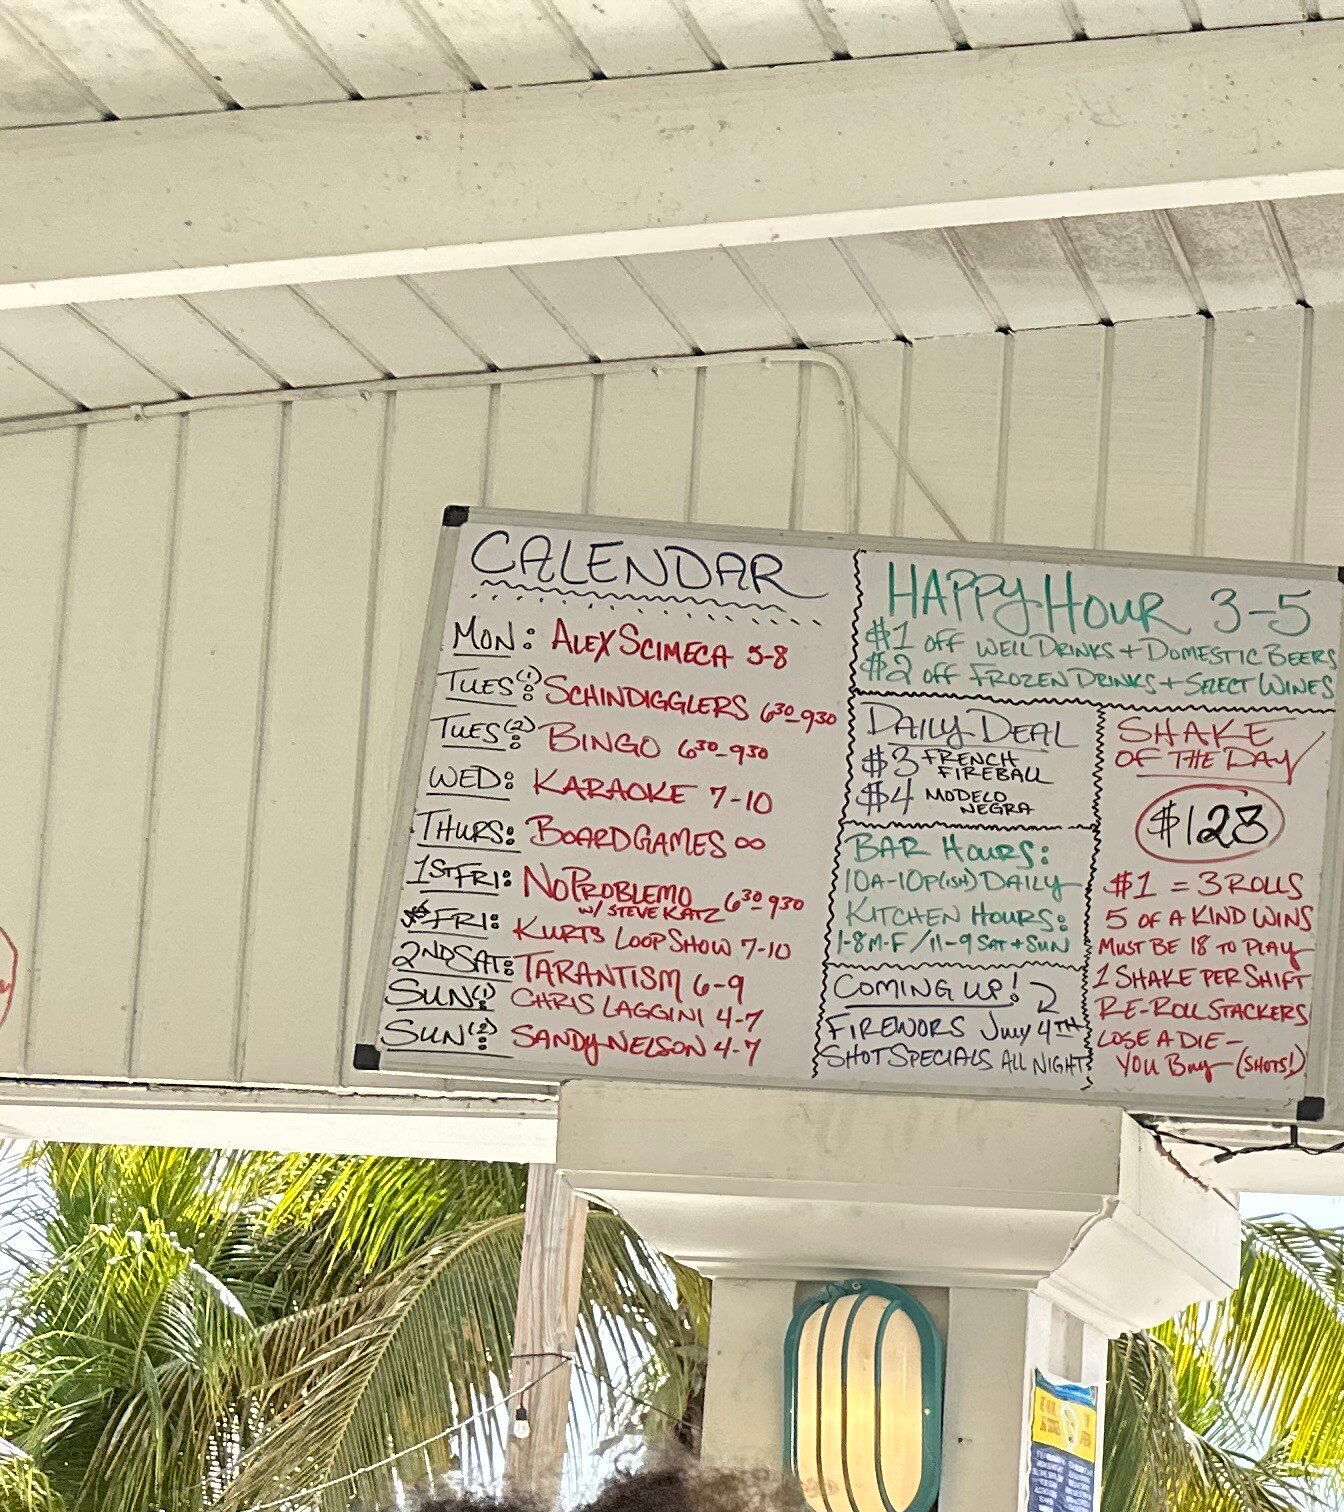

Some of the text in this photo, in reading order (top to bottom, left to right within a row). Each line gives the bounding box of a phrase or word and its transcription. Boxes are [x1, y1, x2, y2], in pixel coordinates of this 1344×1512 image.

[471, 530, 829, 598] CALENDAR
[888, 561, 1312, 636] HAPPY HOUR 3-5
[551, 618, 616, 662] ALEX
[619, 623, 733, 668] SCIMECA
[747, 645, 788, 669] 5-8
[865, 616, 1336, 669] $1 OFF WELL DRINKS DOMESTIC BEERS
[860, 652, 1335, 698] $2 OFF FROZEN DRINKS SELECT WINES
[544, 675, 749, 721] SCHINDIGGLERS
[538, 722, 661, 759] BINGO
[861, 701, 1079, 749] DAILY DEAL
[1118, 717, 1296, 747] SHAKE
[862, 747, 1019, 778] $3 FRENCH
[938, 766, 1054, 784] FIREBALL
[1116, 731, 1326, 785] OF THE DAY
[533, 769, 698, 804] KARAOKE
[710, 786, 773, 814] 7-10
[856, 779, 1007, 815] $4 MODELO
[961, 801, 1035, 815] NEGRA
[525, 815, 630, 849] BOARD
[633, 824, 727, 858] GAMES
[846, 833, 930, 863] BAR
[523, 862, 567, 901] NO
[565, 866, 692, 908] PROBLEMO
[982, 870, 1082, 901] DAILY
[1104, 872, 1303, 900] $1 3 ROLLS
[608, 904, 658, 919] STEVE
[663, 905, 725, 922] KATZ
[847, 898, 961, 926] KITCHEN
[1105, 905, 1313, 932] 5 OF A KIND WINS
[513, 916, 605, 944] KURTS
[615, 927, 665, 951] LOOP
[669, 932, 730, 956] SHOW
[741, 939, 792, 961] 7-10
[837, 931, 864, 953] 1-8
[930, 932, 974, 954] 11-9
[978, 934, 1006, 954] SAT
[1025, 934, 1070, 955] SUN
[1098, 935, 1314, 970] MUST BE 18 TO PLAY
[512, 950, 682, 1002] TARANTISM
[693, 974, 745, 1003] 6-9
[834, 972, 1019, 1006] COMING UP!
[1094, 964, 1311, 990] 1 SHAKE PER SHIFT
[511, 987, 764, 1032] CHRIS LAGGINI 4-7
[1095, 998, 1310, 1027] RE-ROLL STACKERS
[511, 1025, 761, 1066] SANDY NELSON 4-7
[980, 1013, 1030, 1045] JULY
[1098, 1029, 1224, 1050] LOSE A DIE
[821, 1045, 1087, 1076] SHOT SPECIALS ALL NIGHT
[1116, 1054, 1159, 1076] YOU
[1167, 1053, 1220, 1083] BUY
